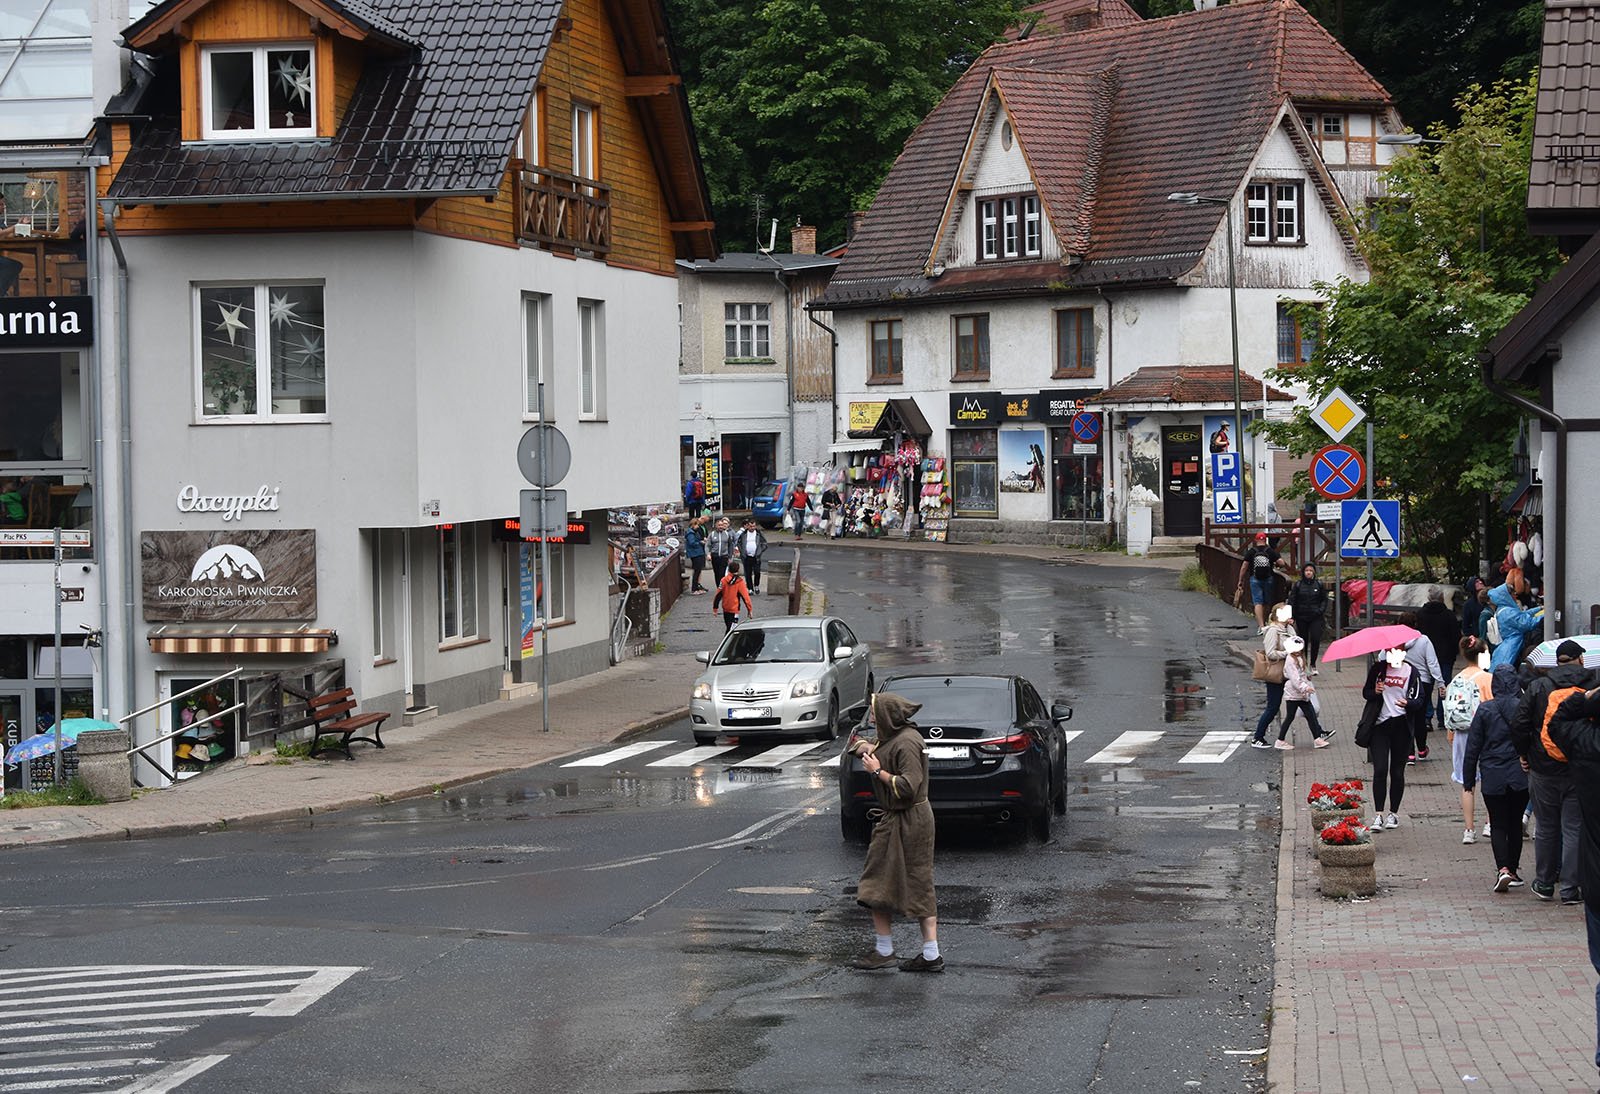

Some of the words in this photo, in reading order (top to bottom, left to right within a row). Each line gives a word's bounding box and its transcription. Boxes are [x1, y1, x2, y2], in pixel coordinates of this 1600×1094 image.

[1049, 400, 1076, 409] REGATTA
[1168, 432, 1198, 440] KEEN
[1217, 454, 1235, 477] P
[177, 485, 280, 521] Oscypki
[158, 585, 233, 597] KARKONOSKA
[237, 584, 298, 597] PIWNICZKA
[217, 599, 243, 607] PROSTO
